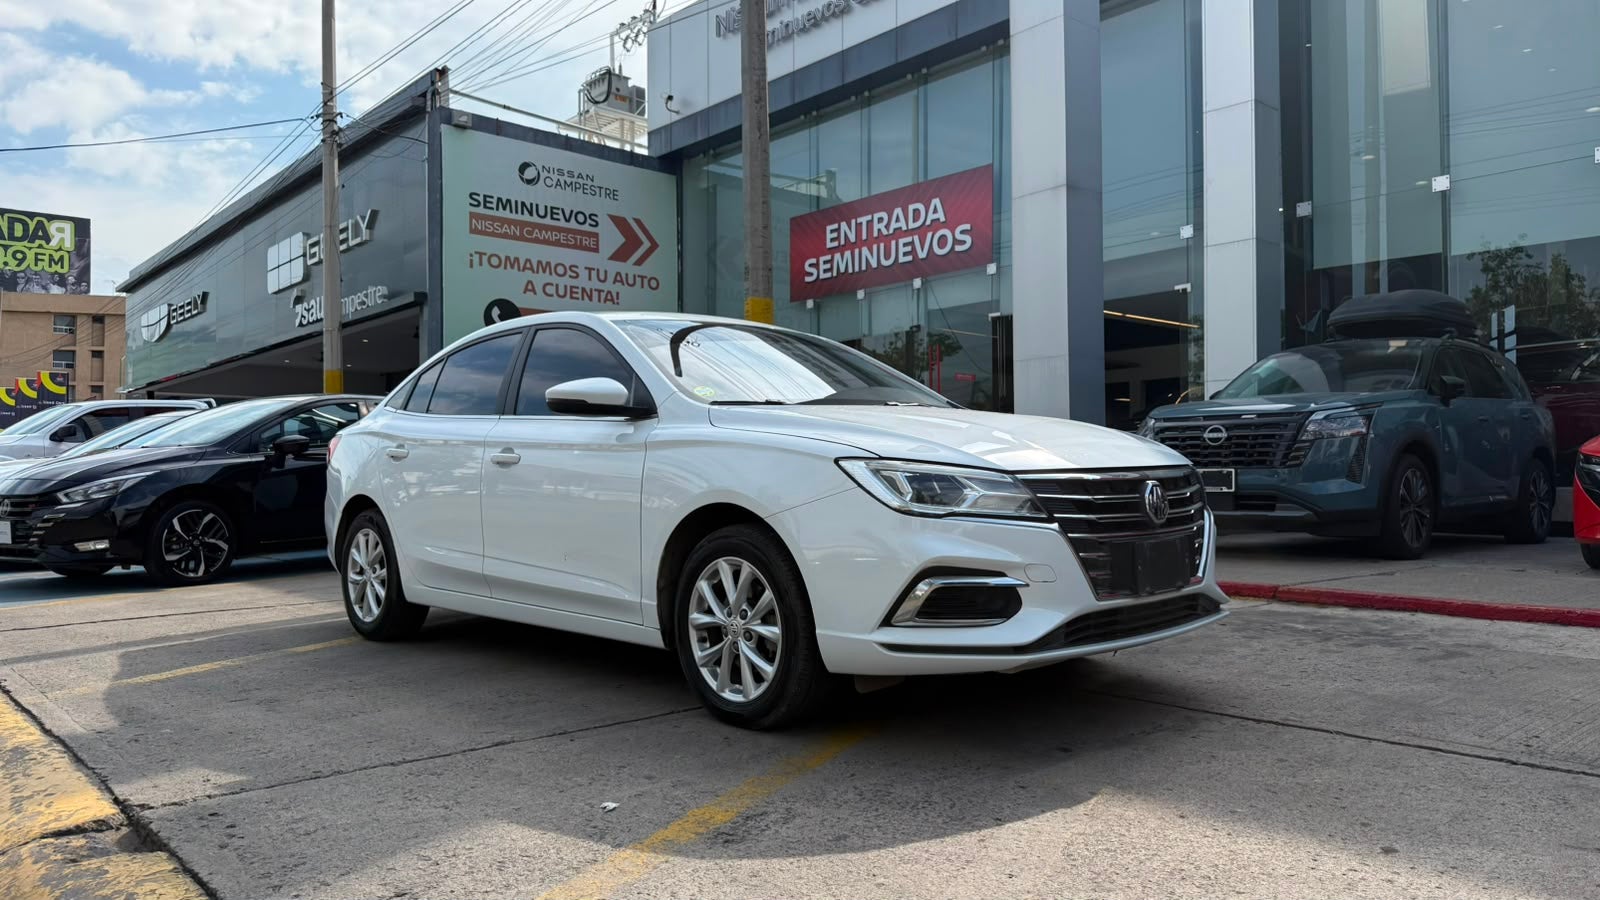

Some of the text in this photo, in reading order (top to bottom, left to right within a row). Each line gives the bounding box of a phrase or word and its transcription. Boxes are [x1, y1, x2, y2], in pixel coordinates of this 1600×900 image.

[542, 165, 595, 183] NISSAN
[543, 176, 619, 201] CAMPESTRE
[468, 192, 599, 228] SEMINUEVOS
[826, 197, 946, 249] ENTRADA
[307, 209, 374, 265] GELY
[472, 218, 598, 248] NISSAN CAMPESTRE
[469, 251, 660, 291] ¡TOMAMOS TU AUTO
[804, 224, 972, 283] SEMINUEVOS
[170, 291, 206, 325] GEELY
[523, 280, 620, 305] A CUENTA!
